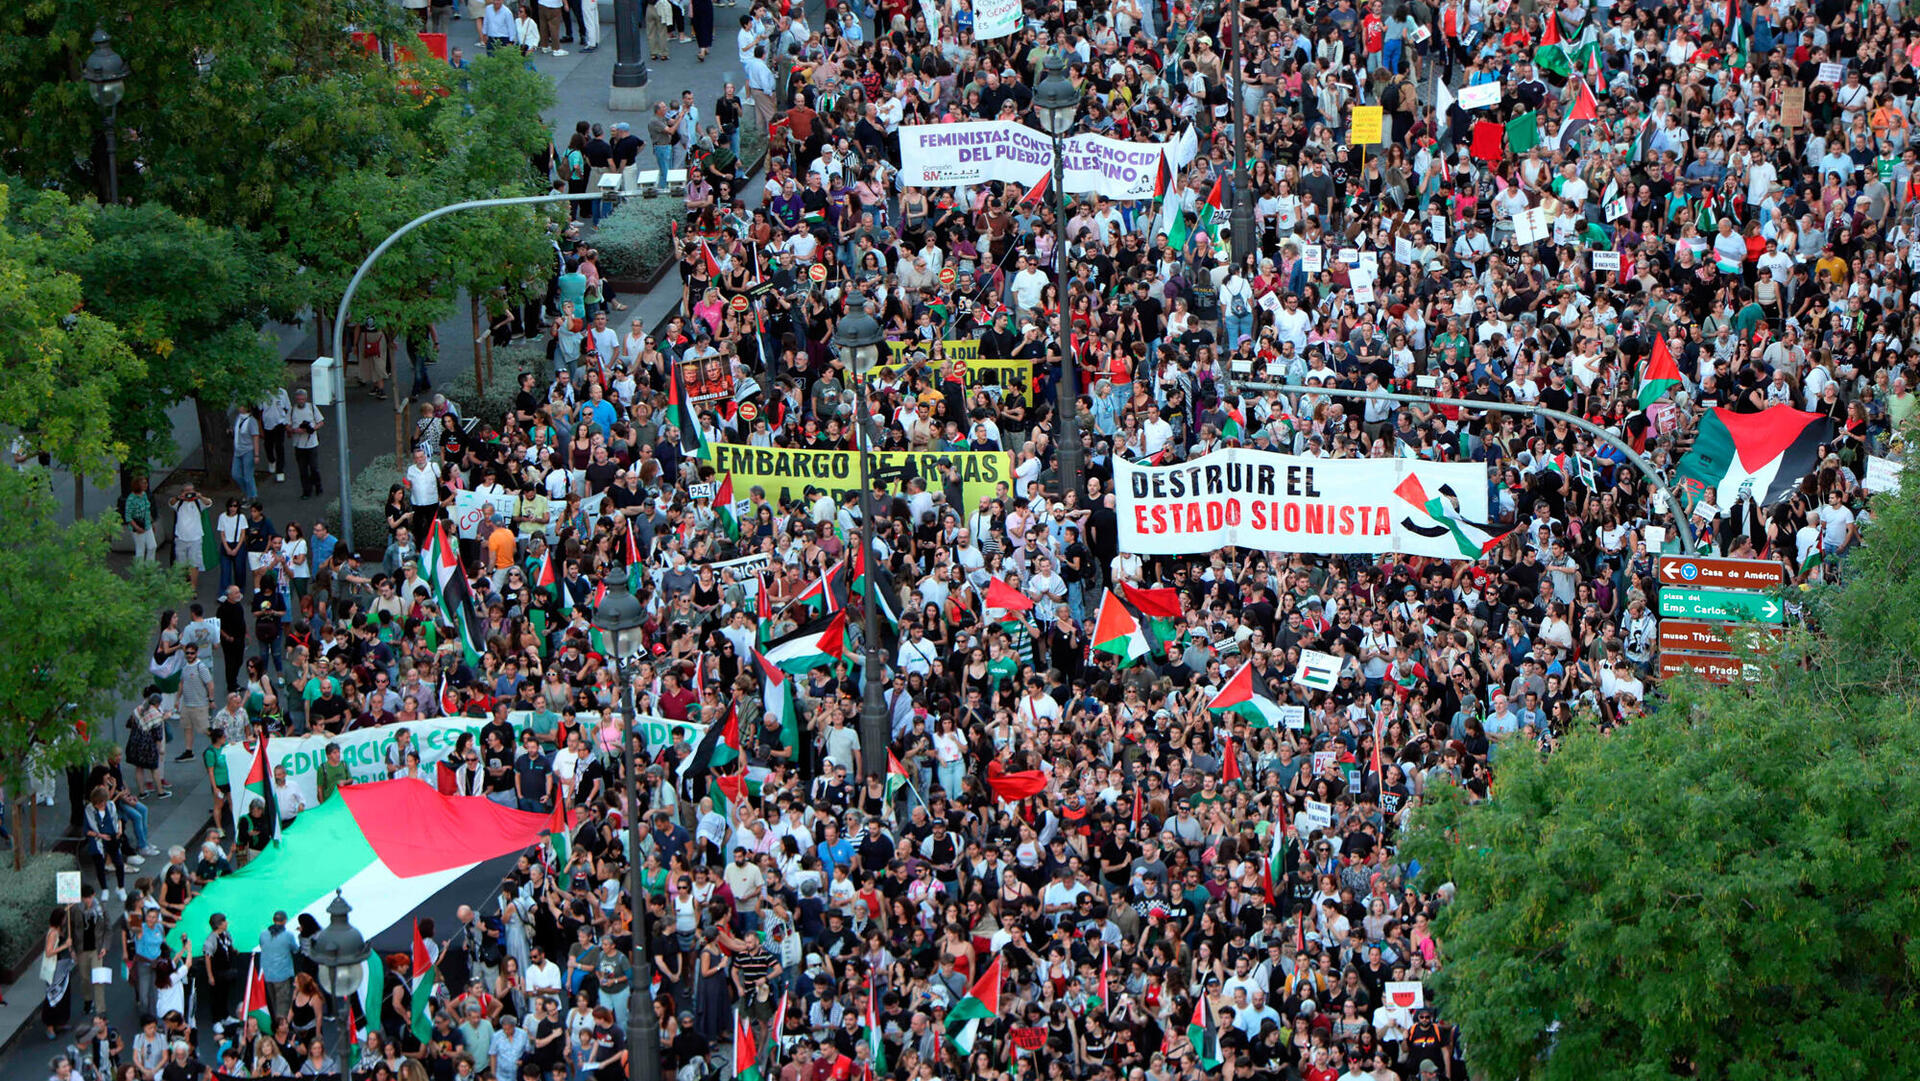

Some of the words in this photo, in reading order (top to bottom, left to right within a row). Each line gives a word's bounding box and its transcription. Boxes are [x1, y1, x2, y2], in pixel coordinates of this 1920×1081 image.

[920, 129, 1010, 148] FEMINISTAS
[1067, 140, 1083, 154] EL
[1085, 141, 1162, 166] GENOCID
[959, 147, 992, 163] DEL
[995, 144, 1052, 167] PUEBLO
[1060, 154, 1138, 183] ALESINO
[1213, 210, 1232, 220] PAZ
[716, 446, 851, 480] EMBARGO
[1131, 461, 1276, 499] DESTRUIR
[1286, 466, 1321, 498] EL
[690, 484, 709, 496] PAZ
[1134, 497, 1242, 535] ESTADO
[1251, 499, 1391, 536] SIONISTA
[1701, 568, 1723, 577] Casa
[1728, 570, 1739, 578] de
[1744, 571, 1780, 581] América
[1688, 594, 1700, 602] del
[1663, 603, 1688, 613] Emp.
[1709, 666, 1739, 676] Prado
